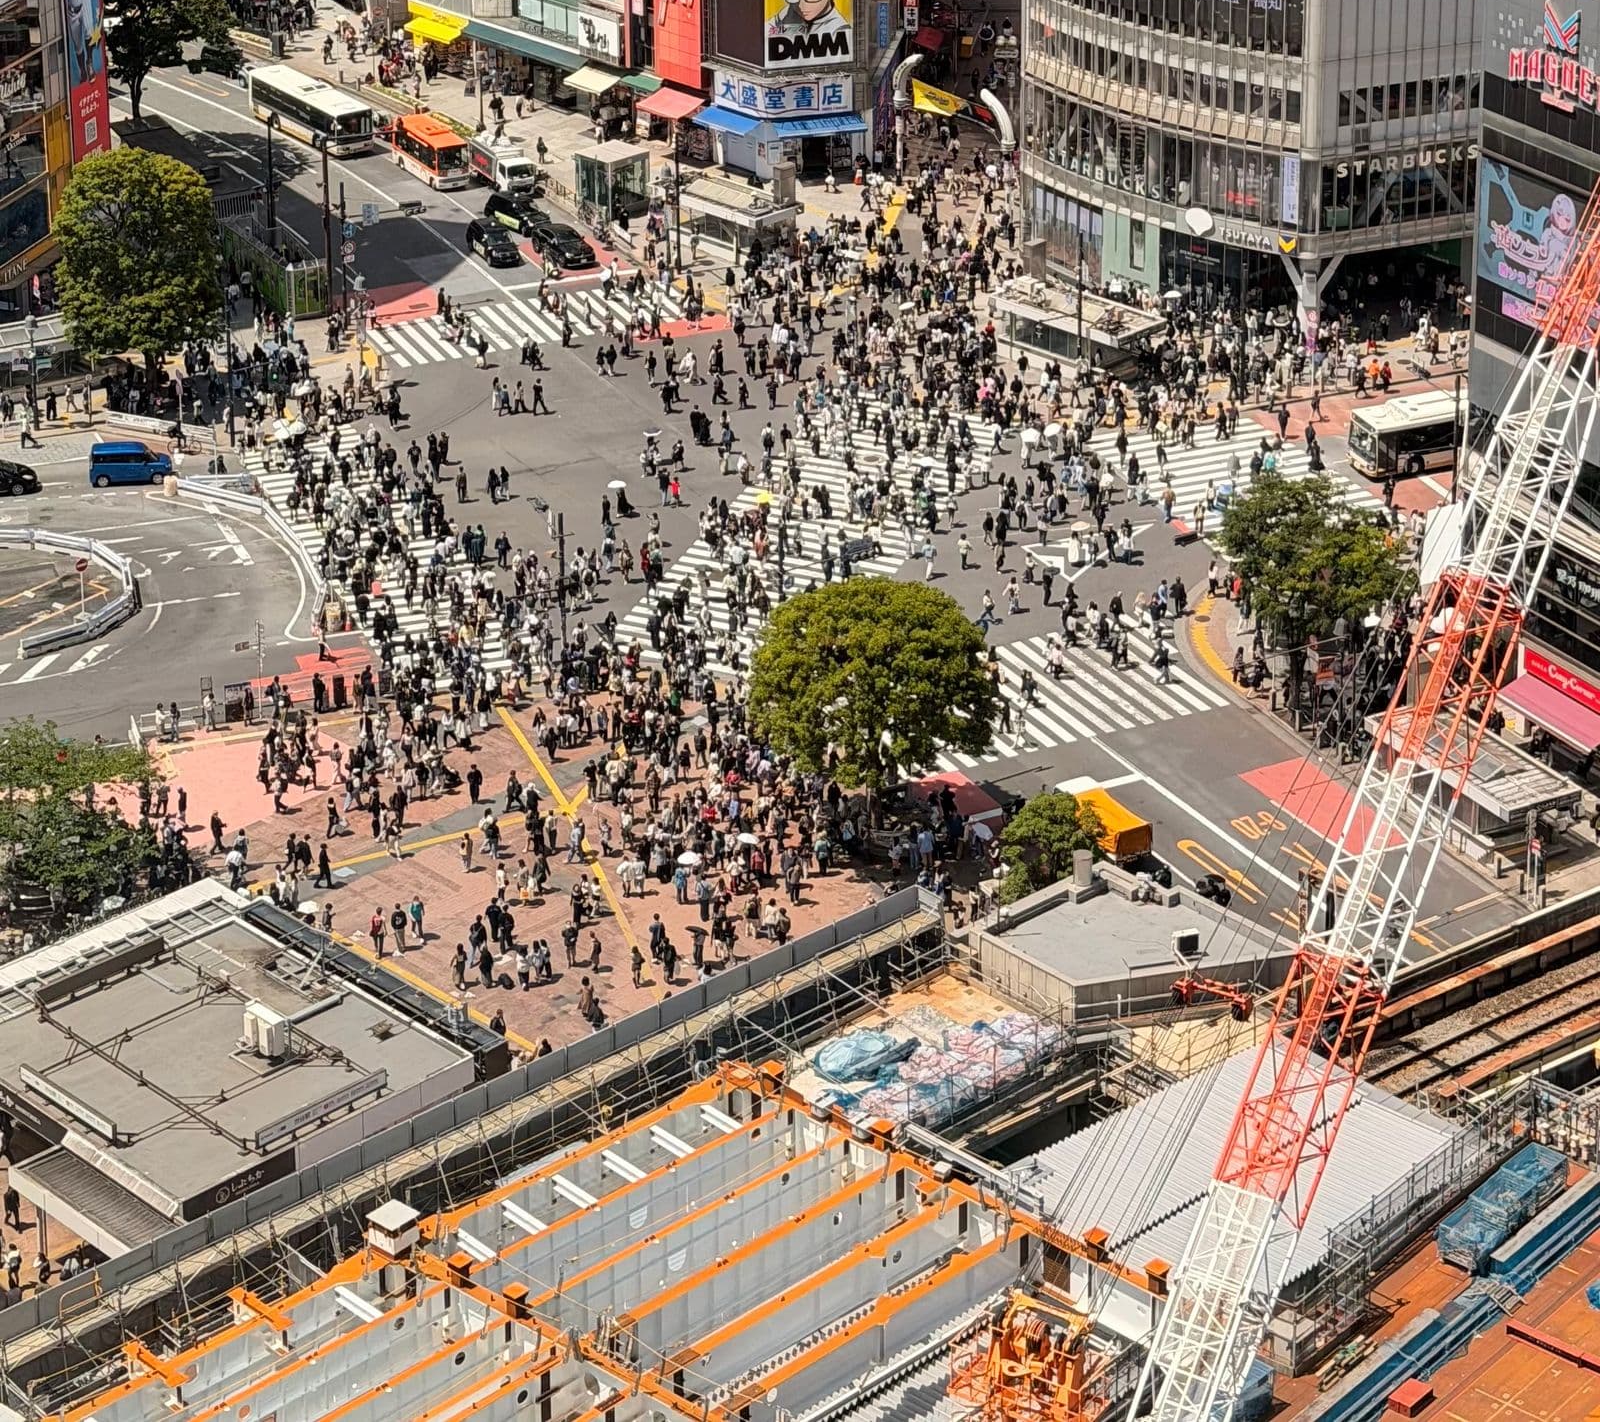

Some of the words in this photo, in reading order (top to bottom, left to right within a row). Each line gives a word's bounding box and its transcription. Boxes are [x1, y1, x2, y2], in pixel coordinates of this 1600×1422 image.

[768, 31, 849, 62] DMM
[721, 79, 843, 110] 大盛堂書店
[1508, 48, 1600, 113] MAGNE
[1048, 147, 1161, 199] STARBUCKS
[1336, 144, 1480, 178] STARBUCKS
[1218, 227, 1272, 247] TSUTAYA
